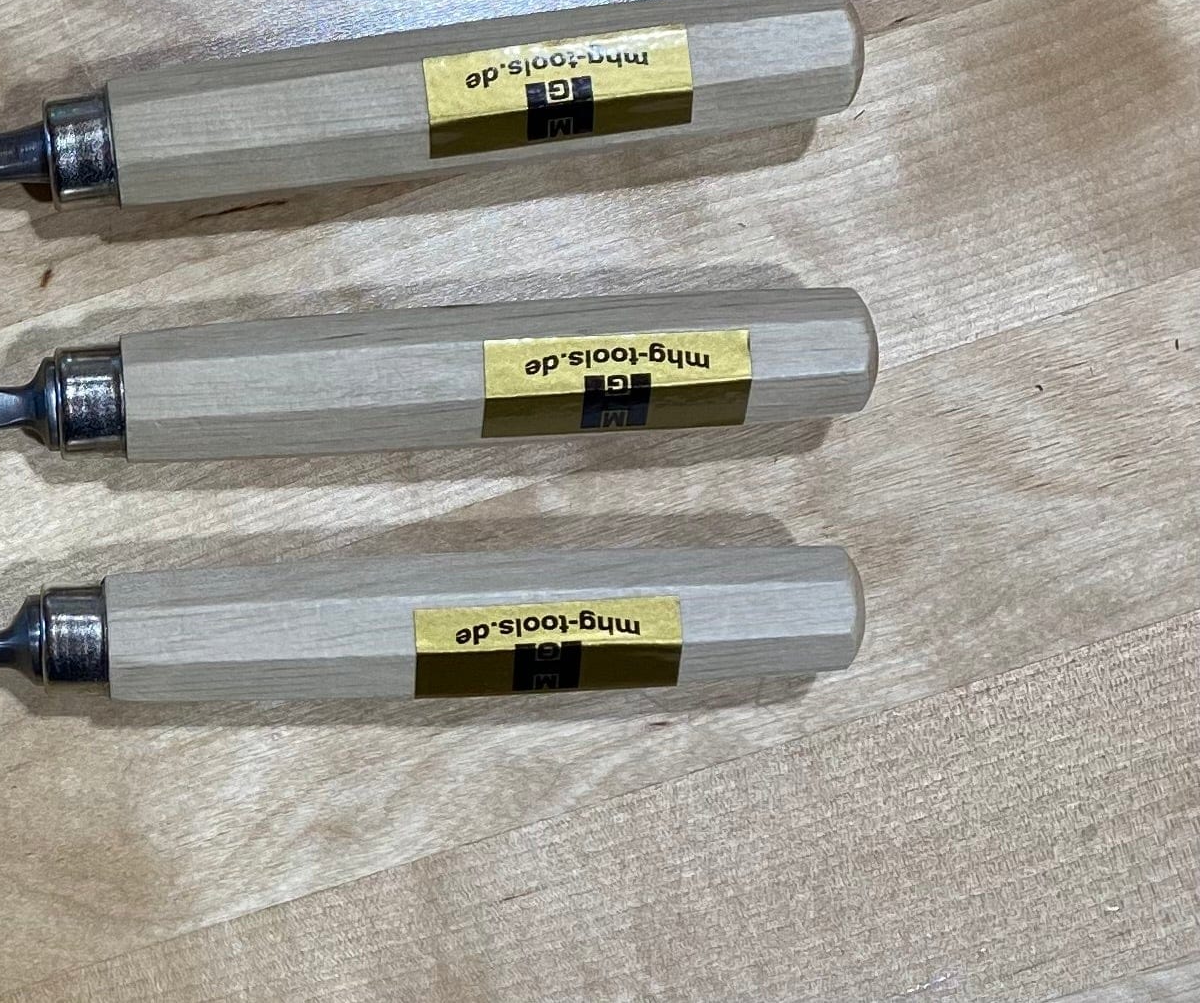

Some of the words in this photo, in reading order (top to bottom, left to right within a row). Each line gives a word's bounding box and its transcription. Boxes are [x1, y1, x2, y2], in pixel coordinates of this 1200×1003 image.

[466, 46, 648, 91] mhg-tools.de
[525, 344, 711, 377] mhg-tools.de
[455, 612, 641, 647] mhg-tools.de
